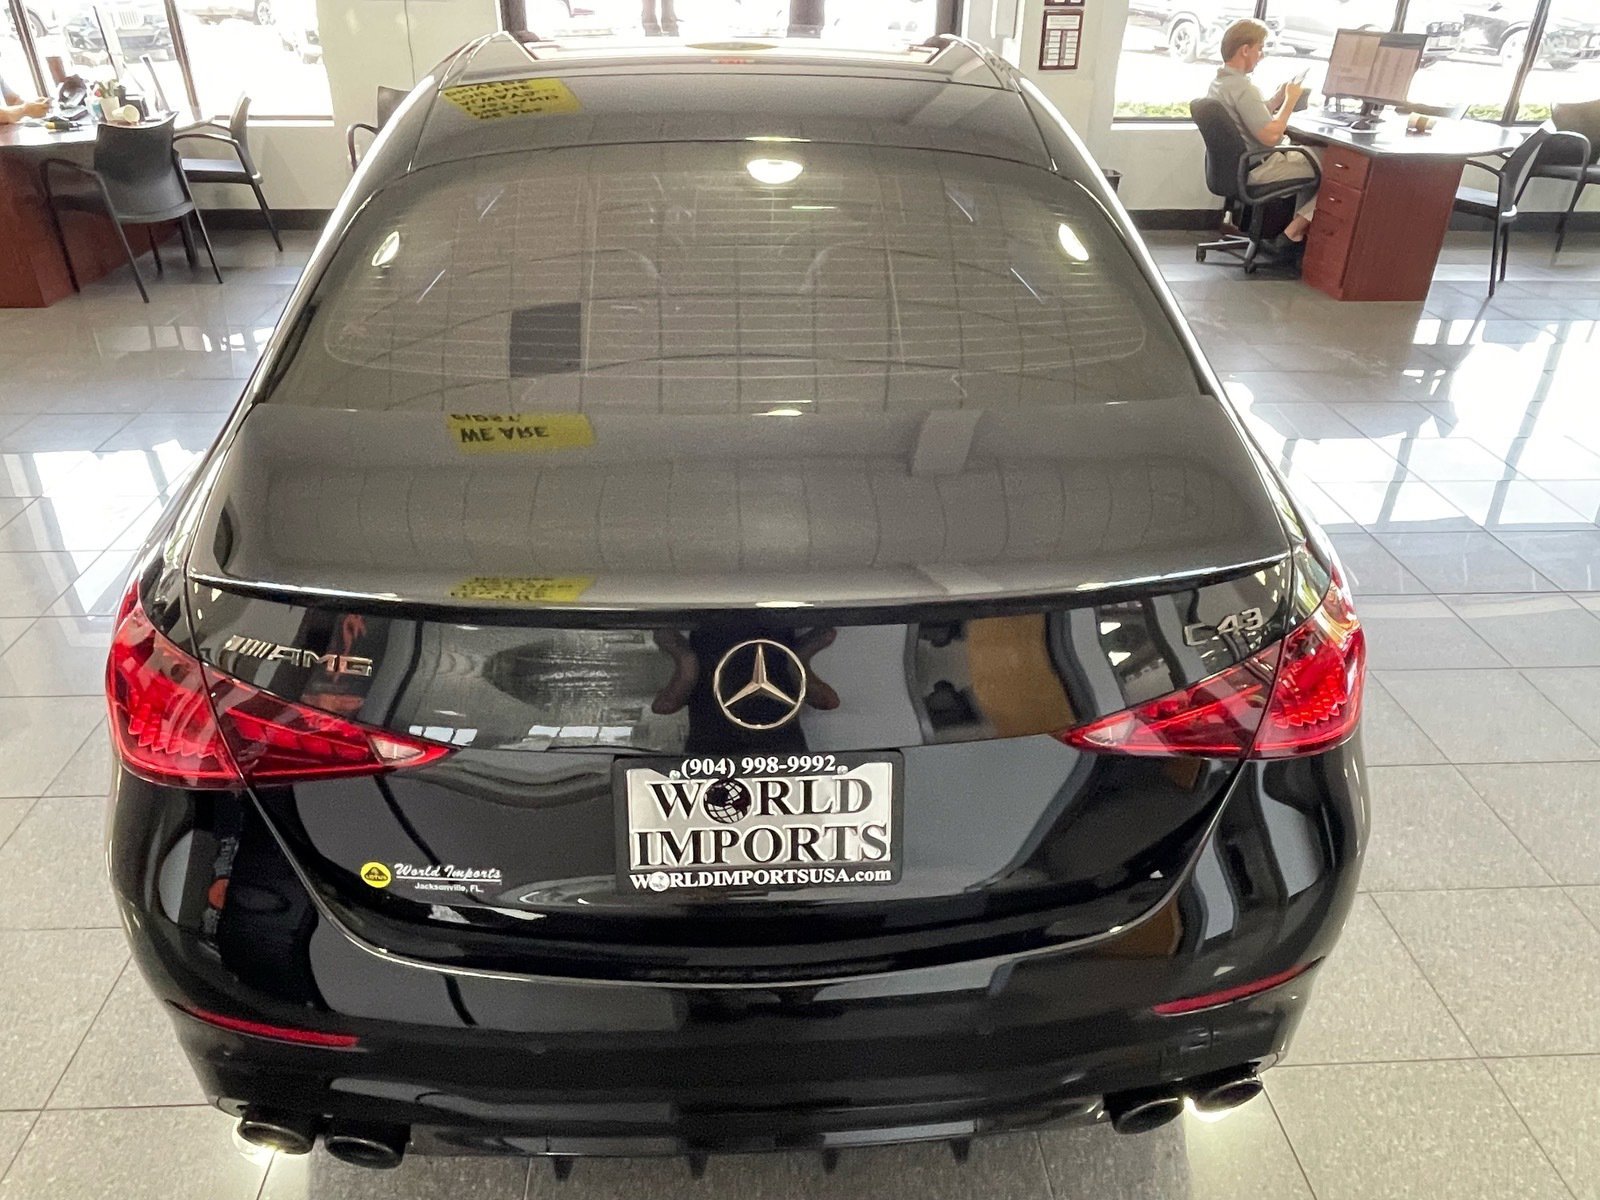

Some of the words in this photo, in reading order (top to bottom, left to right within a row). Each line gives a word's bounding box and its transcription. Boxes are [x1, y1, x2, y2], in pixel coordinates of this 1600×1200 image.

[681, 758, 736, 779] (904)
[741, 755, 836, 775] 998-9992
[647, 776, 873, 825] WORLD
[633, 822, 889, 867] IMPORTS
[394, 863, 441, 877] World
[443, 865, 502, 880] Imports
[629, 868, 892, 893] WORLDIMPORTSUSA.com
